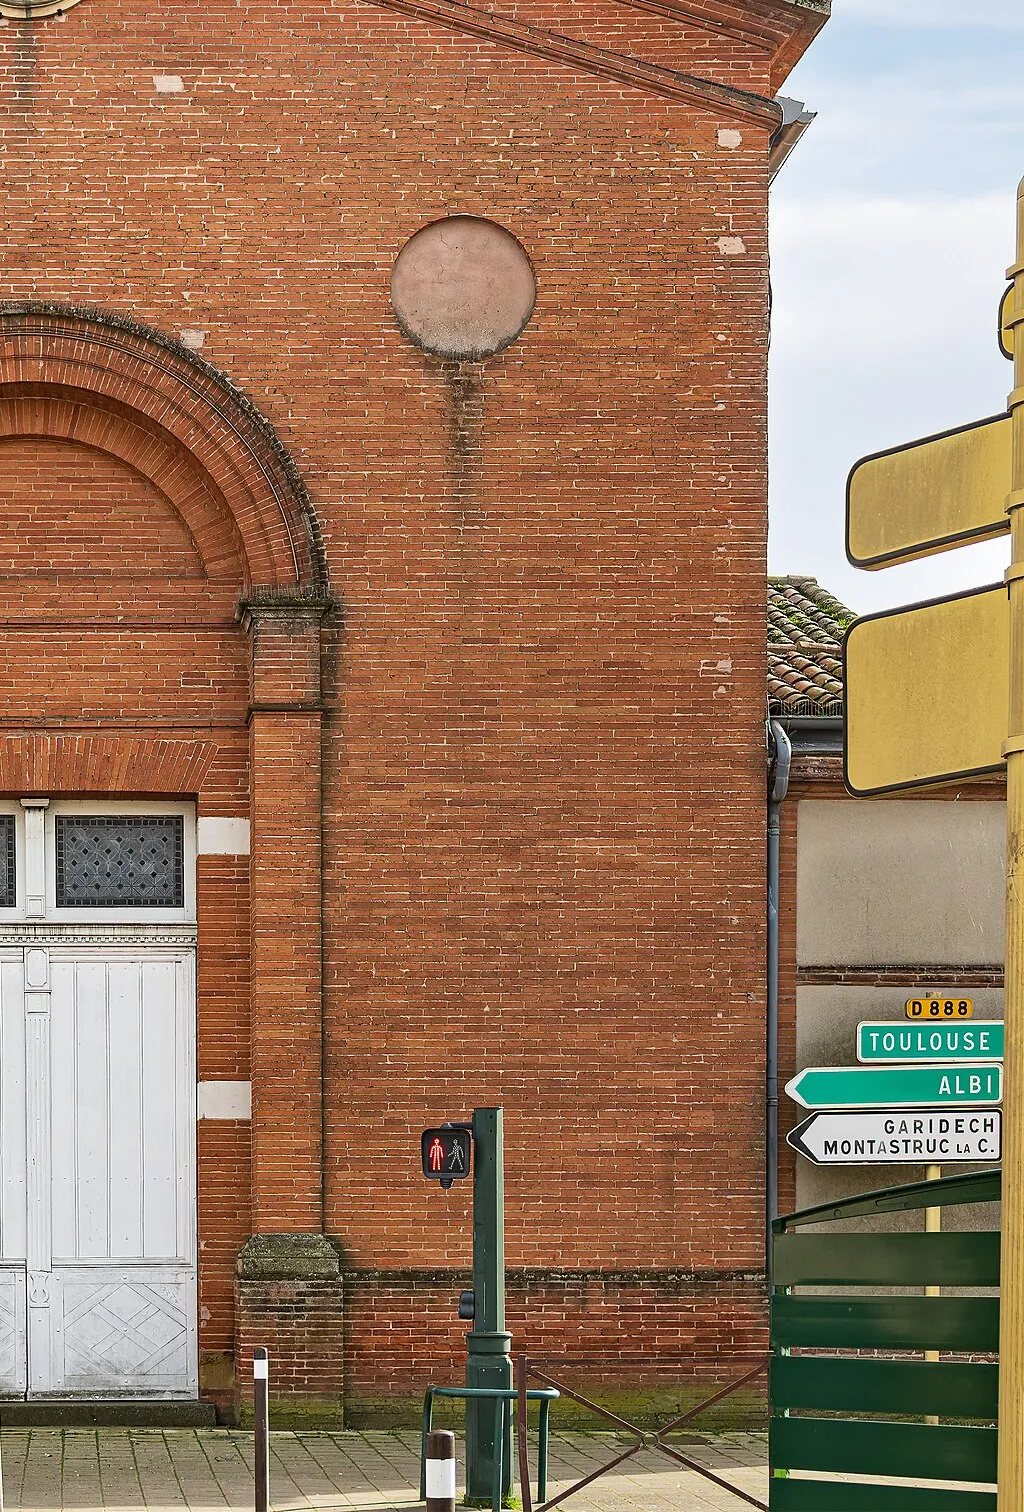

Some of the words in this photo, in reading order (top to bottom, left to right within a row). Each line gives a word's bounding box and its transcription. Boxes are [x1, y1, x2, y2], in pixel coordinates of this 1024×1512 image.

[911, 1000, 923, 1016] D
[929, 1000, 968, 1016] 888
[869, 1031, 991, 1052] TOULOUSE
[938, 1074, 992, 1095] ALBI
[884, 1117, 995, 1135] GARIDECH
[824, 1138, 950, 1156] MONTASTRUC
[956, 1143, 971, 1154] LA
[977, 1138, 996, 1154] C.
